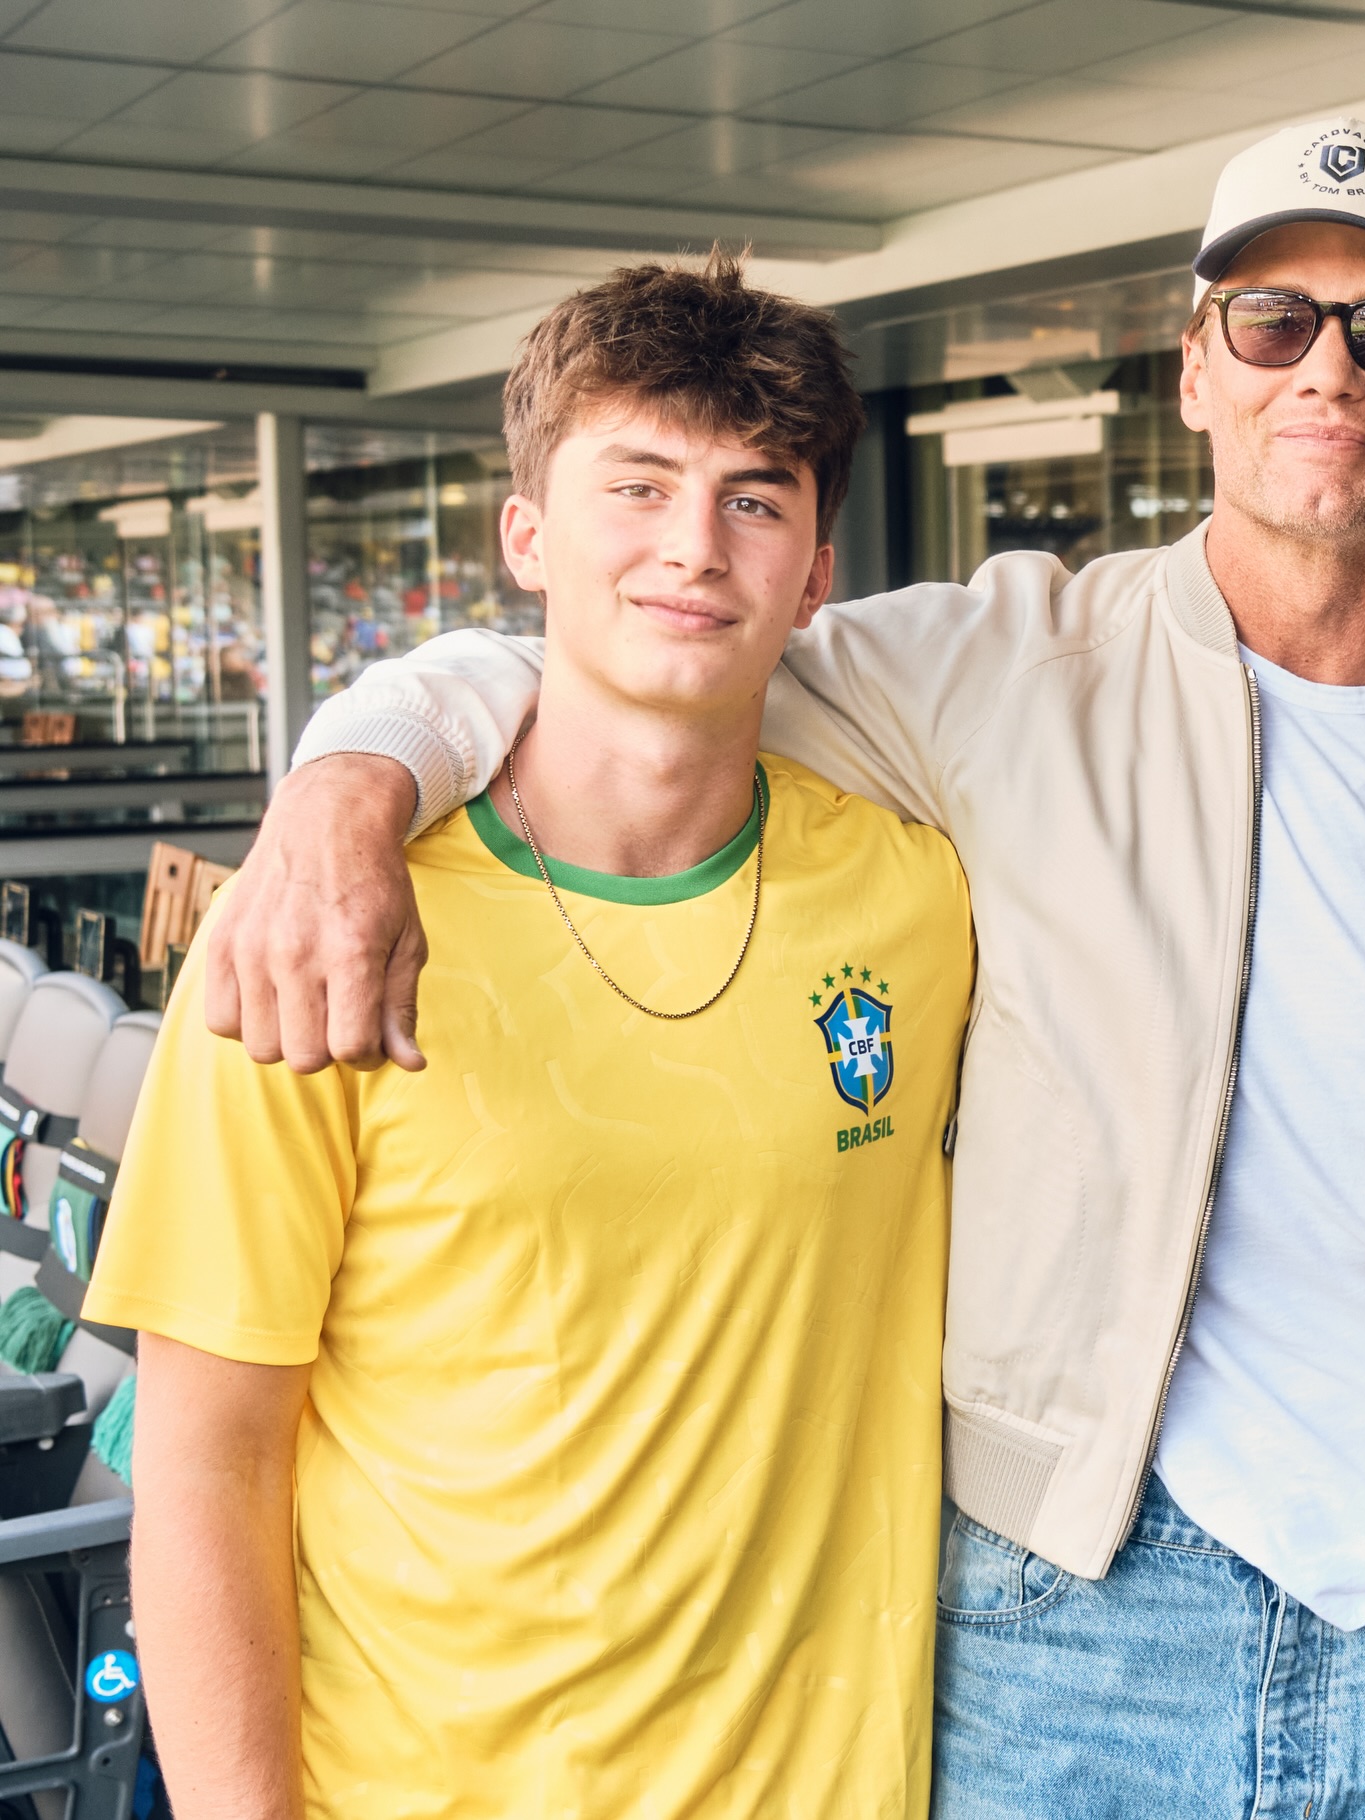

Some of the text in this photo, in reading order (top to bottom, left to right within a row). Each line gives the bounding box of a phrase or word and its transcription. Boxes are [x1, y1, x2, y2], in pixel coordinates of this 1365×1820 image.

[1300, 172, 1311, 184] BY
[1312, 184, 1340, 195] TOM
[849, 1037, 875, 1056] CBF
[837, 1115, 895, 1153] BRASIL
